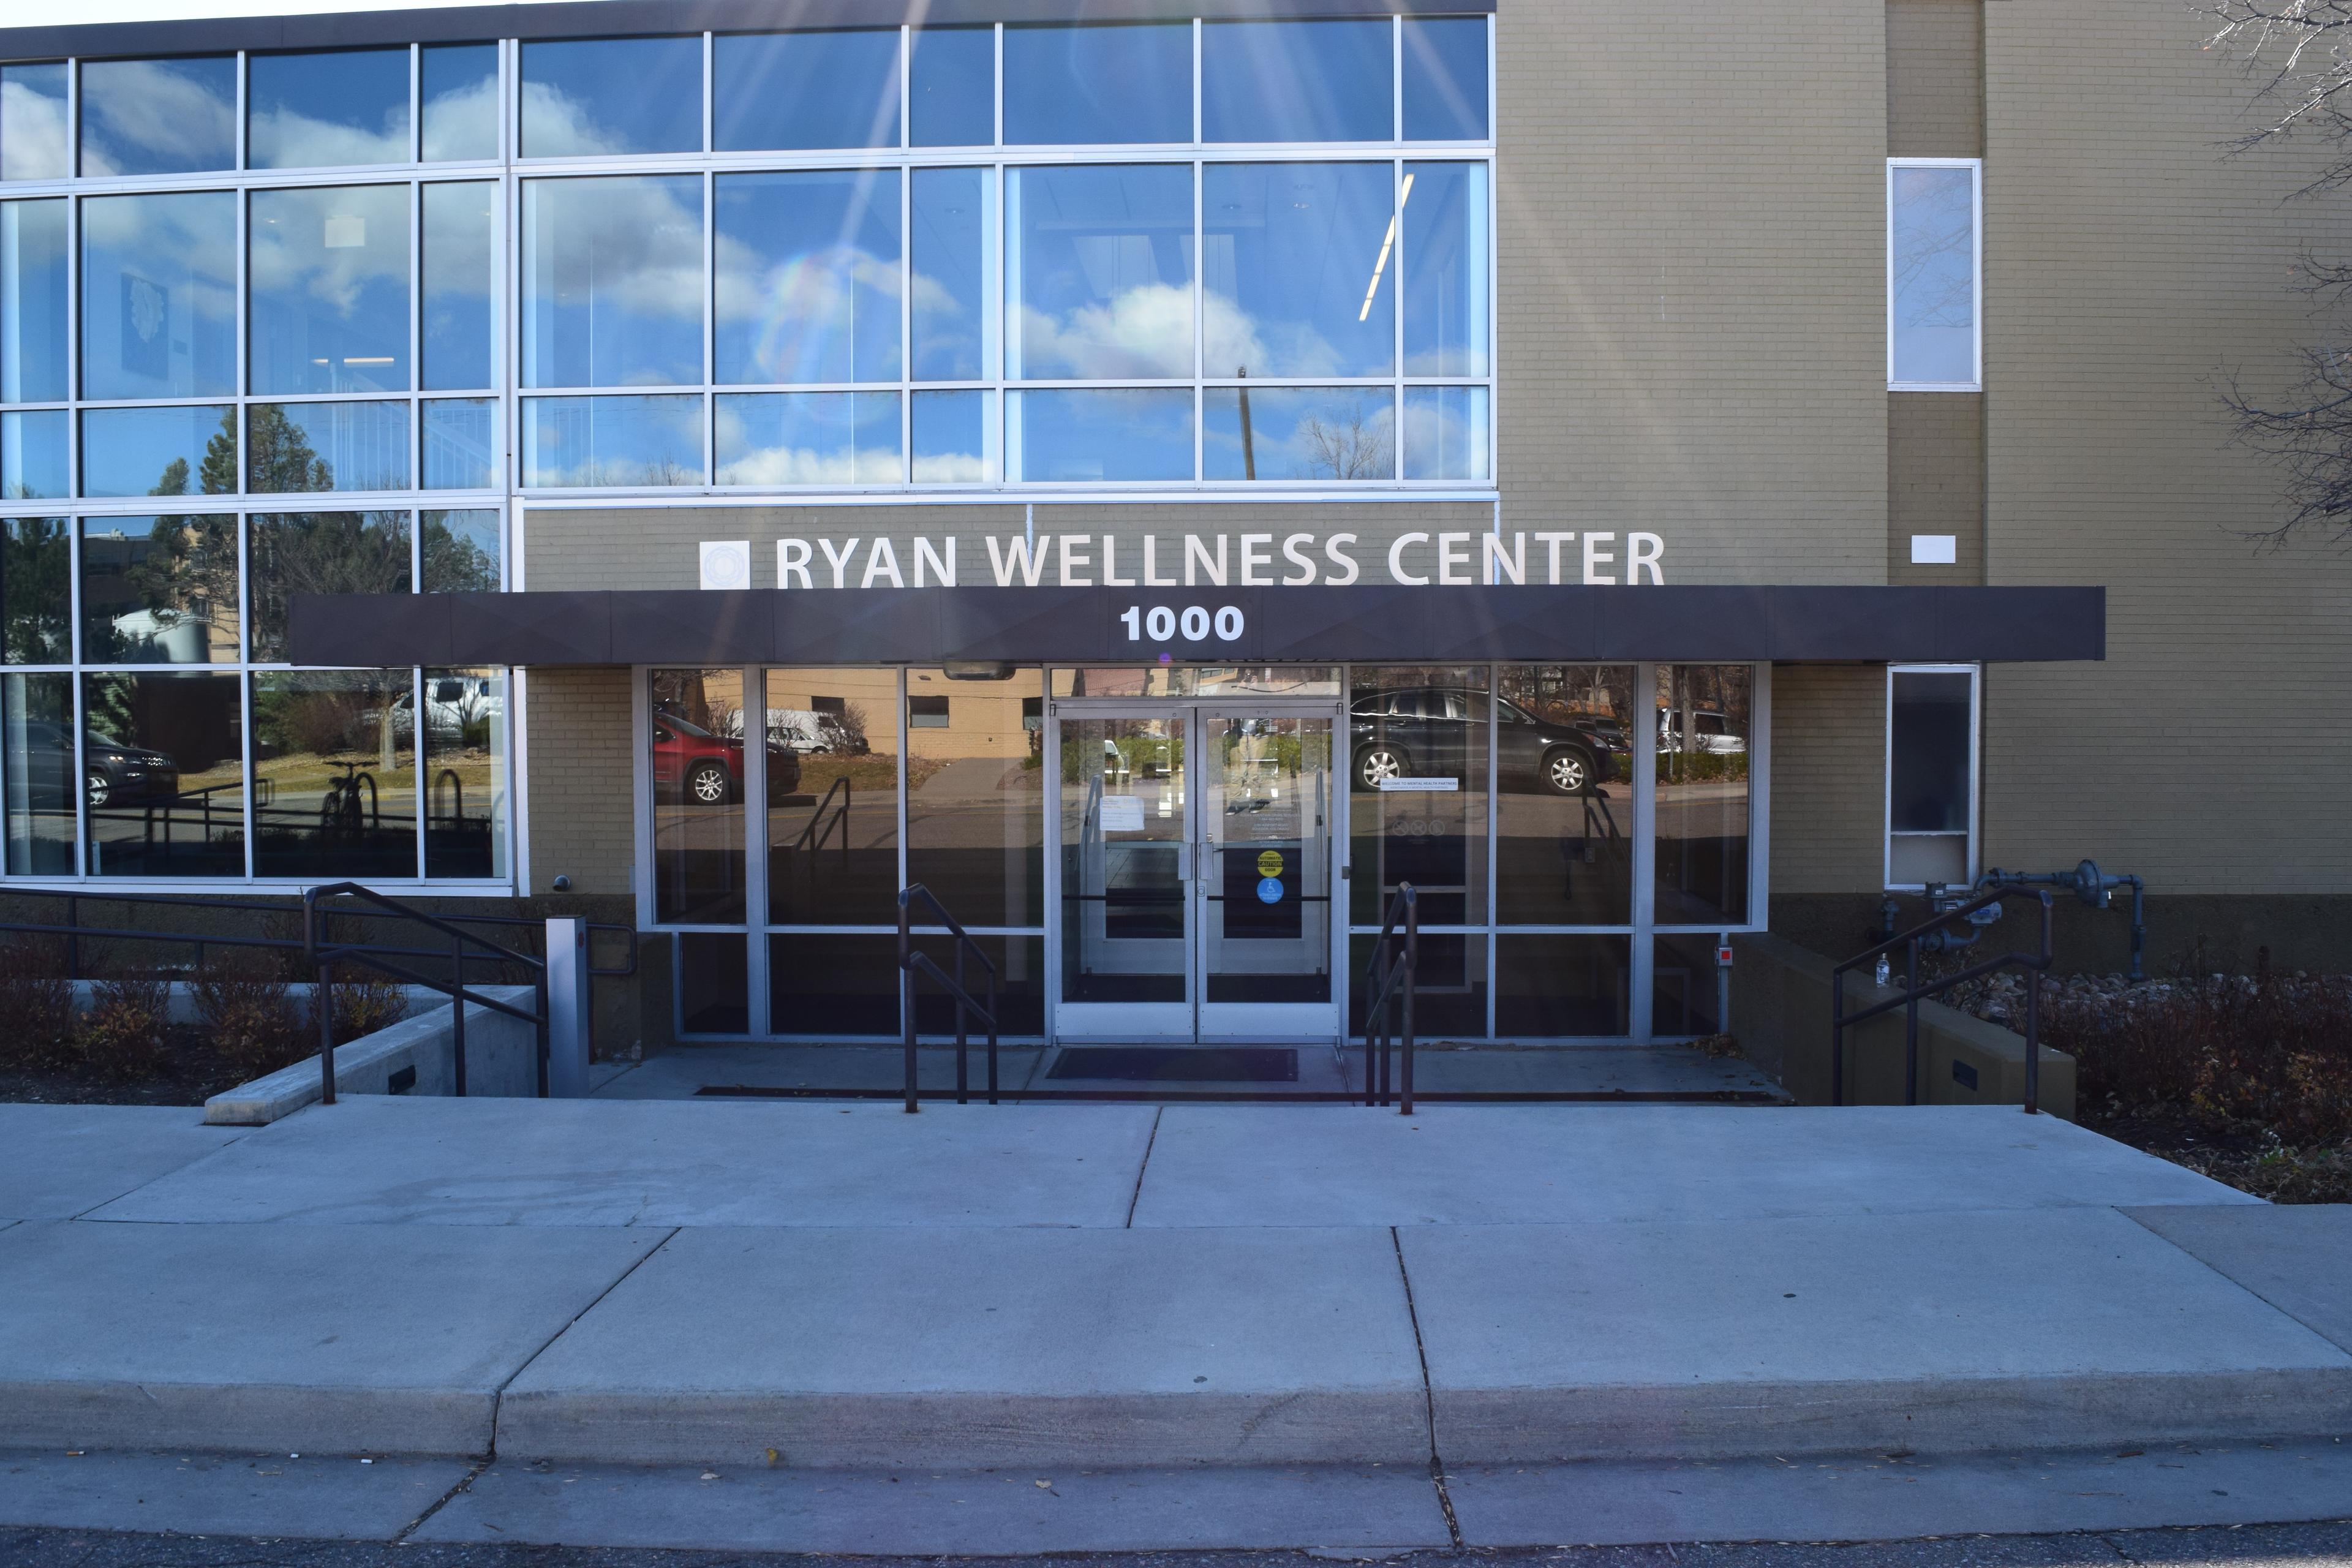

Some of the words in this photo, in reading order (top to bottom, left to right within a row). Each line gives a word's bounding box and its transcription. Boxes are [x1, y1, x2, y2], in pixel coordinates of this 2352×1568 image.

[776, 537, 956, 590] RYAN
[985, 534, 1359, 586] WELLNESS
[1389, 532, 1664, 586] CENTER
[1121, 606, 1244, 641] 1000
